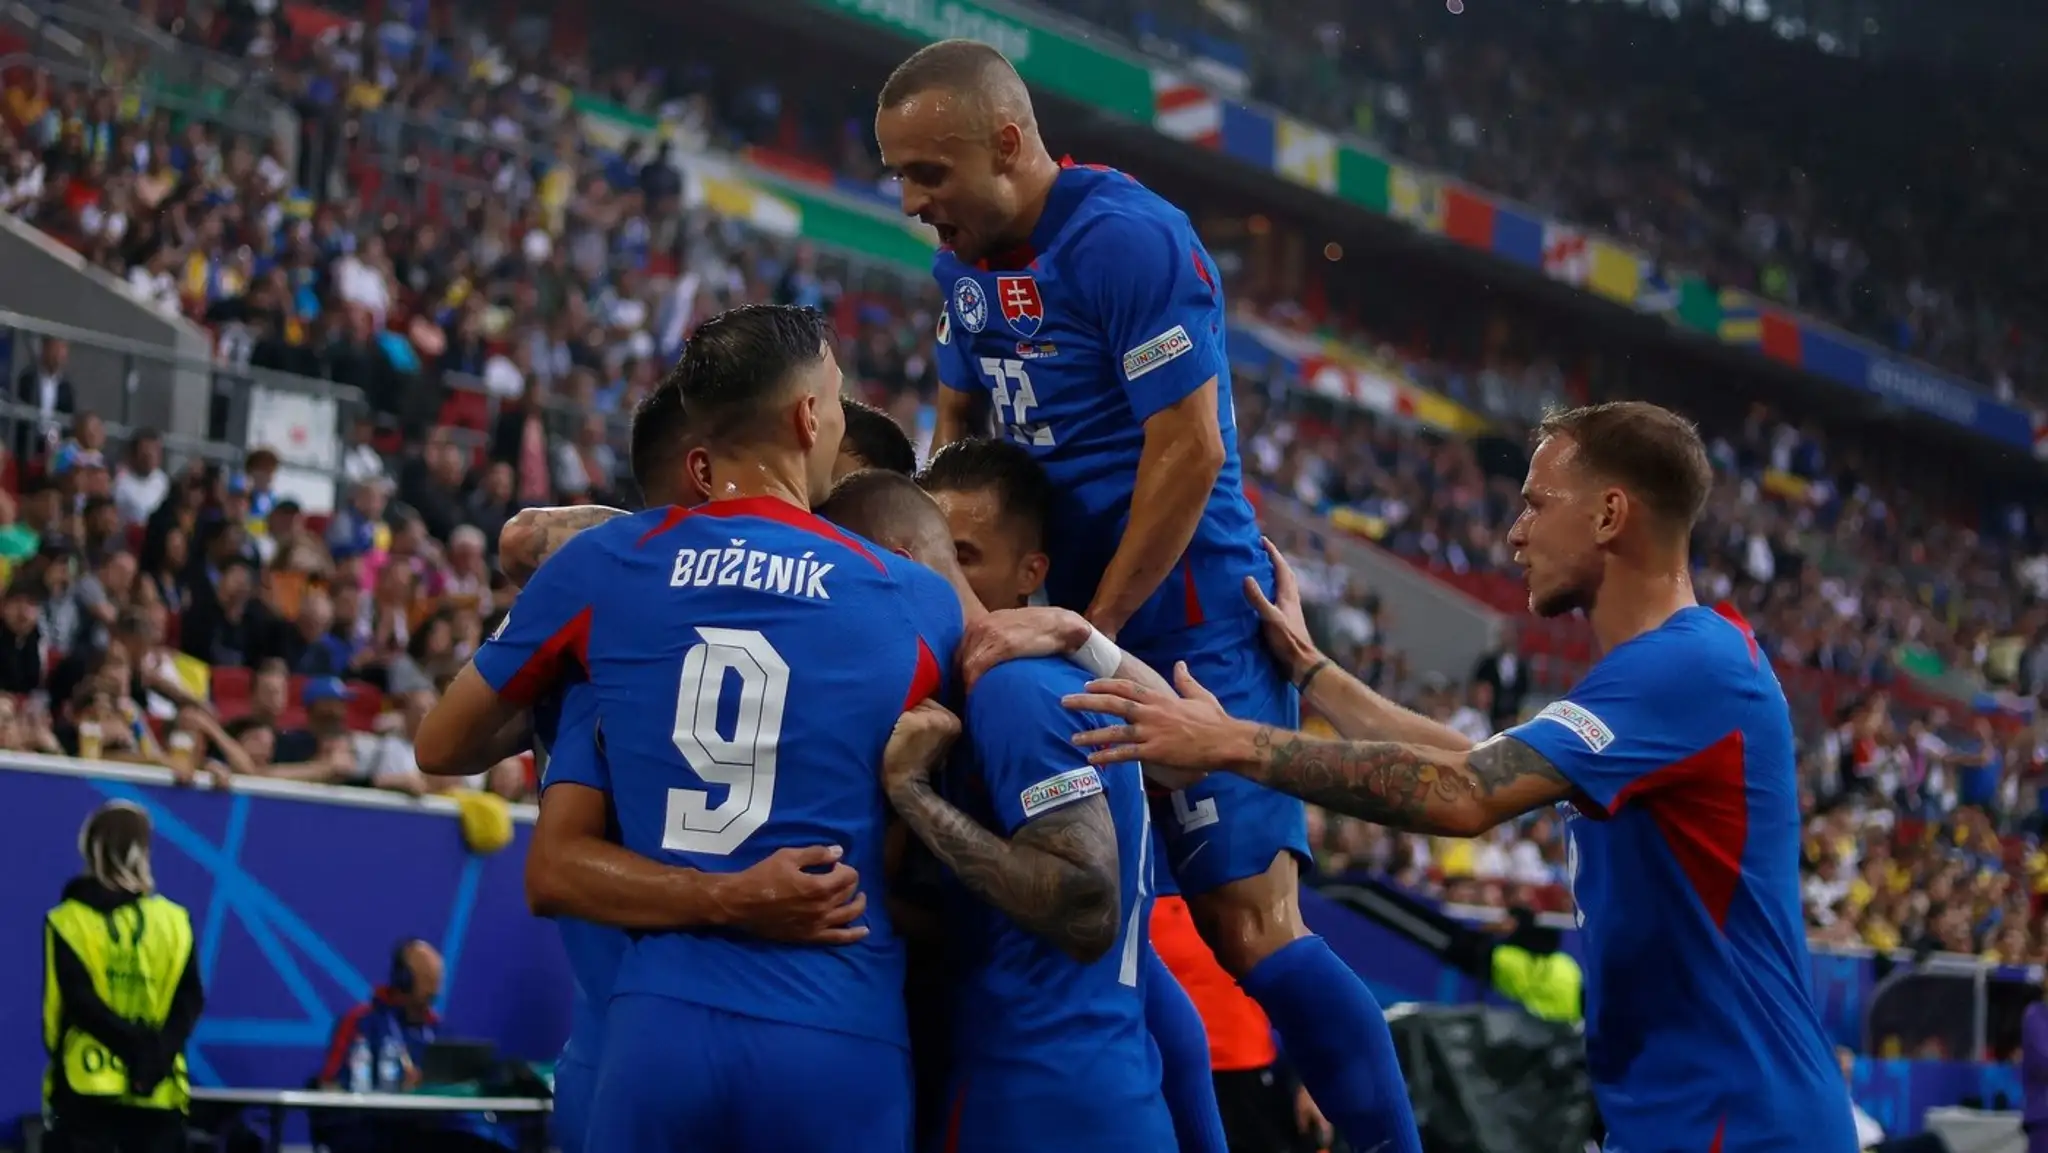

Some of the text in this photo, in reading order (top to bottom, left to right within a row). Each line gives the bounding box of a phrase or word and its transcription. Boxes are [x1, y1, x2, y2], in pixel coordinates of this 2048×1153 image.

[669, 538, 835, 600] BOŽENÍK
[661, 626, 790, 855] 9
[1551, 704, 1608, 746] NDATION
[1023, 774, 1099, 808] FOUNDATION
